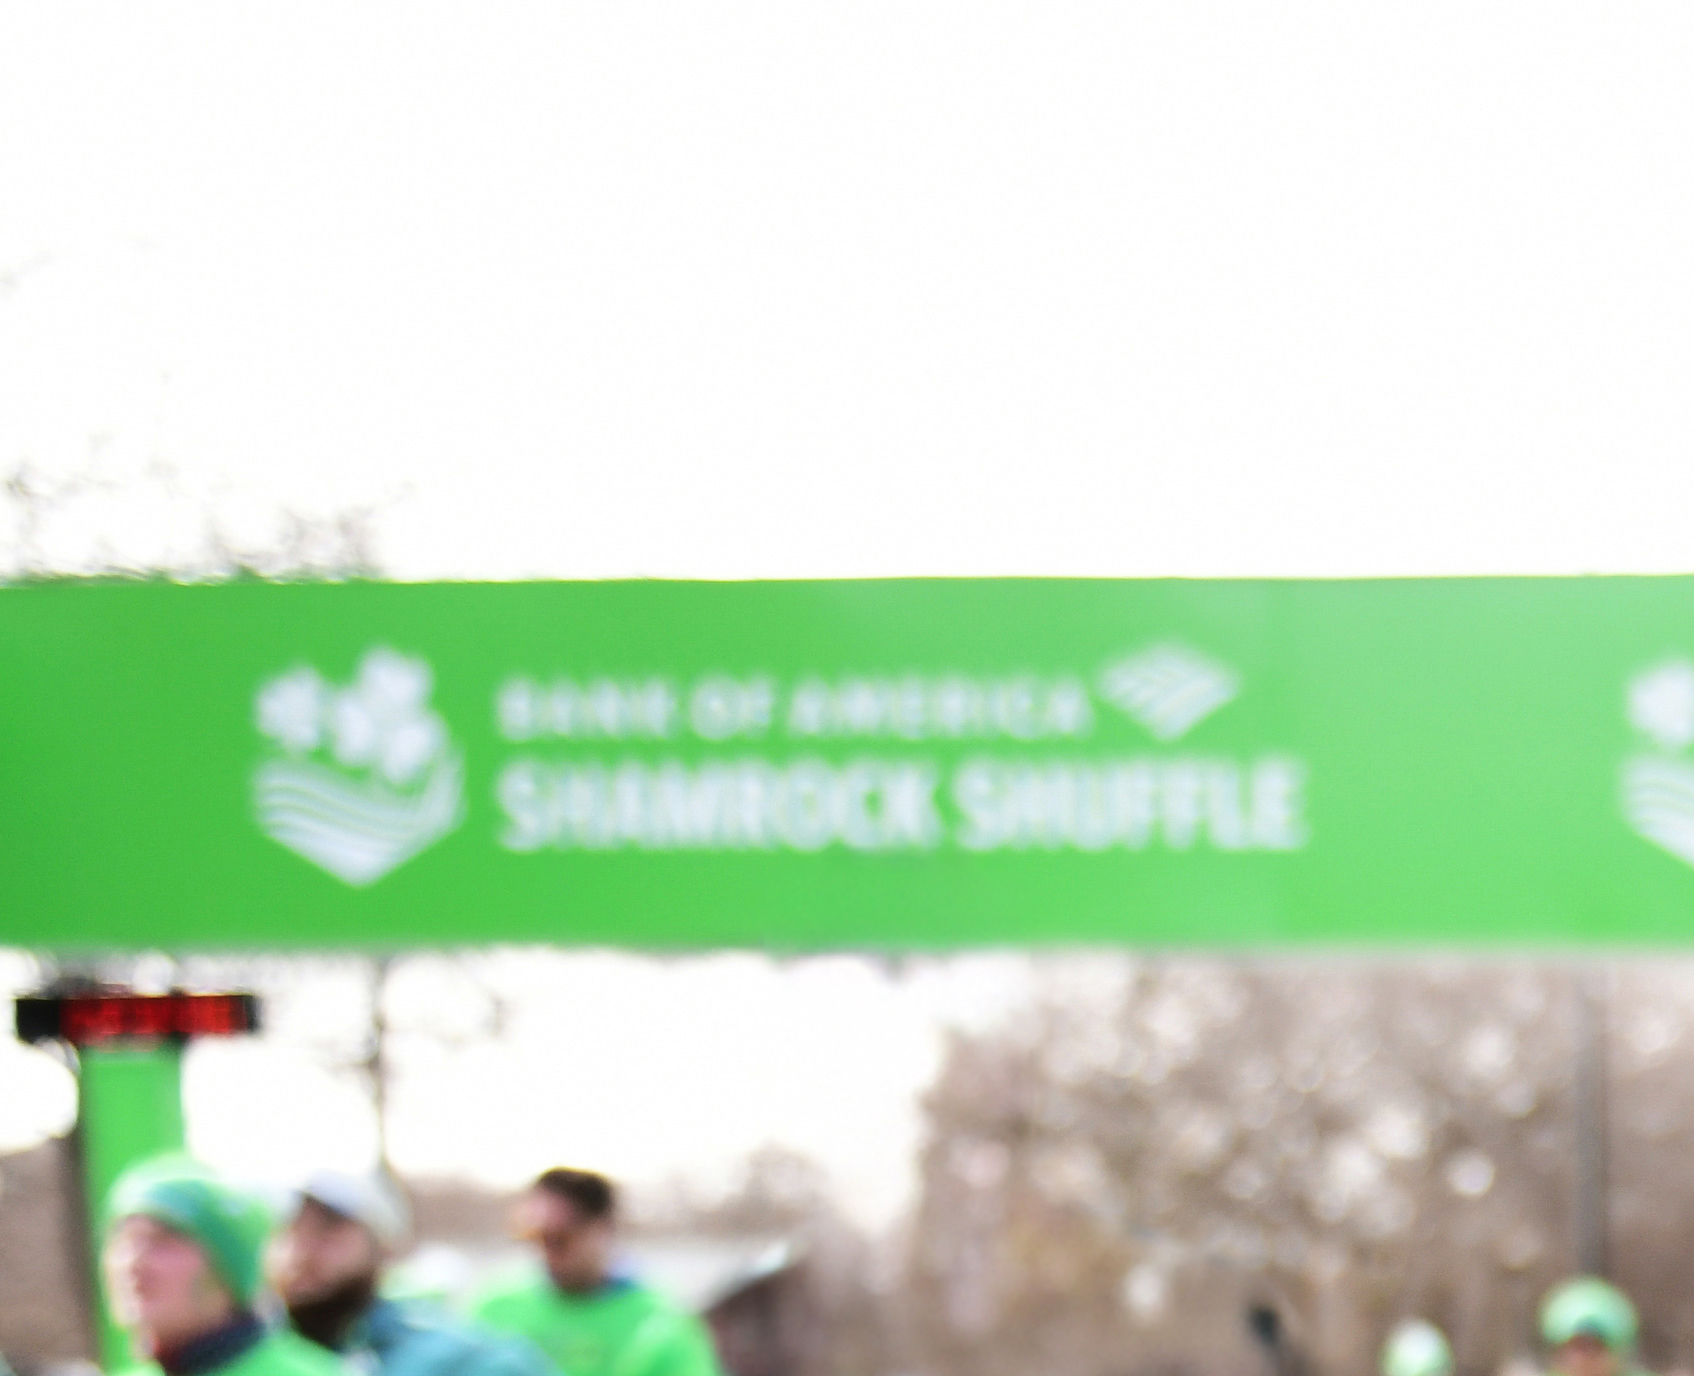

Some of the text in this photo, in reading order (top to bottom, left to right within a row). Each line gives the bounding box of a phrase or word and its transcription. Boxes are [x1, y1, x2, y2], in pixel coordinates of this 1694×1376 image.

[691, 675, 777, 743] OF
[495, 759, 1307, 852] SHAMROCK SHUFFLE
